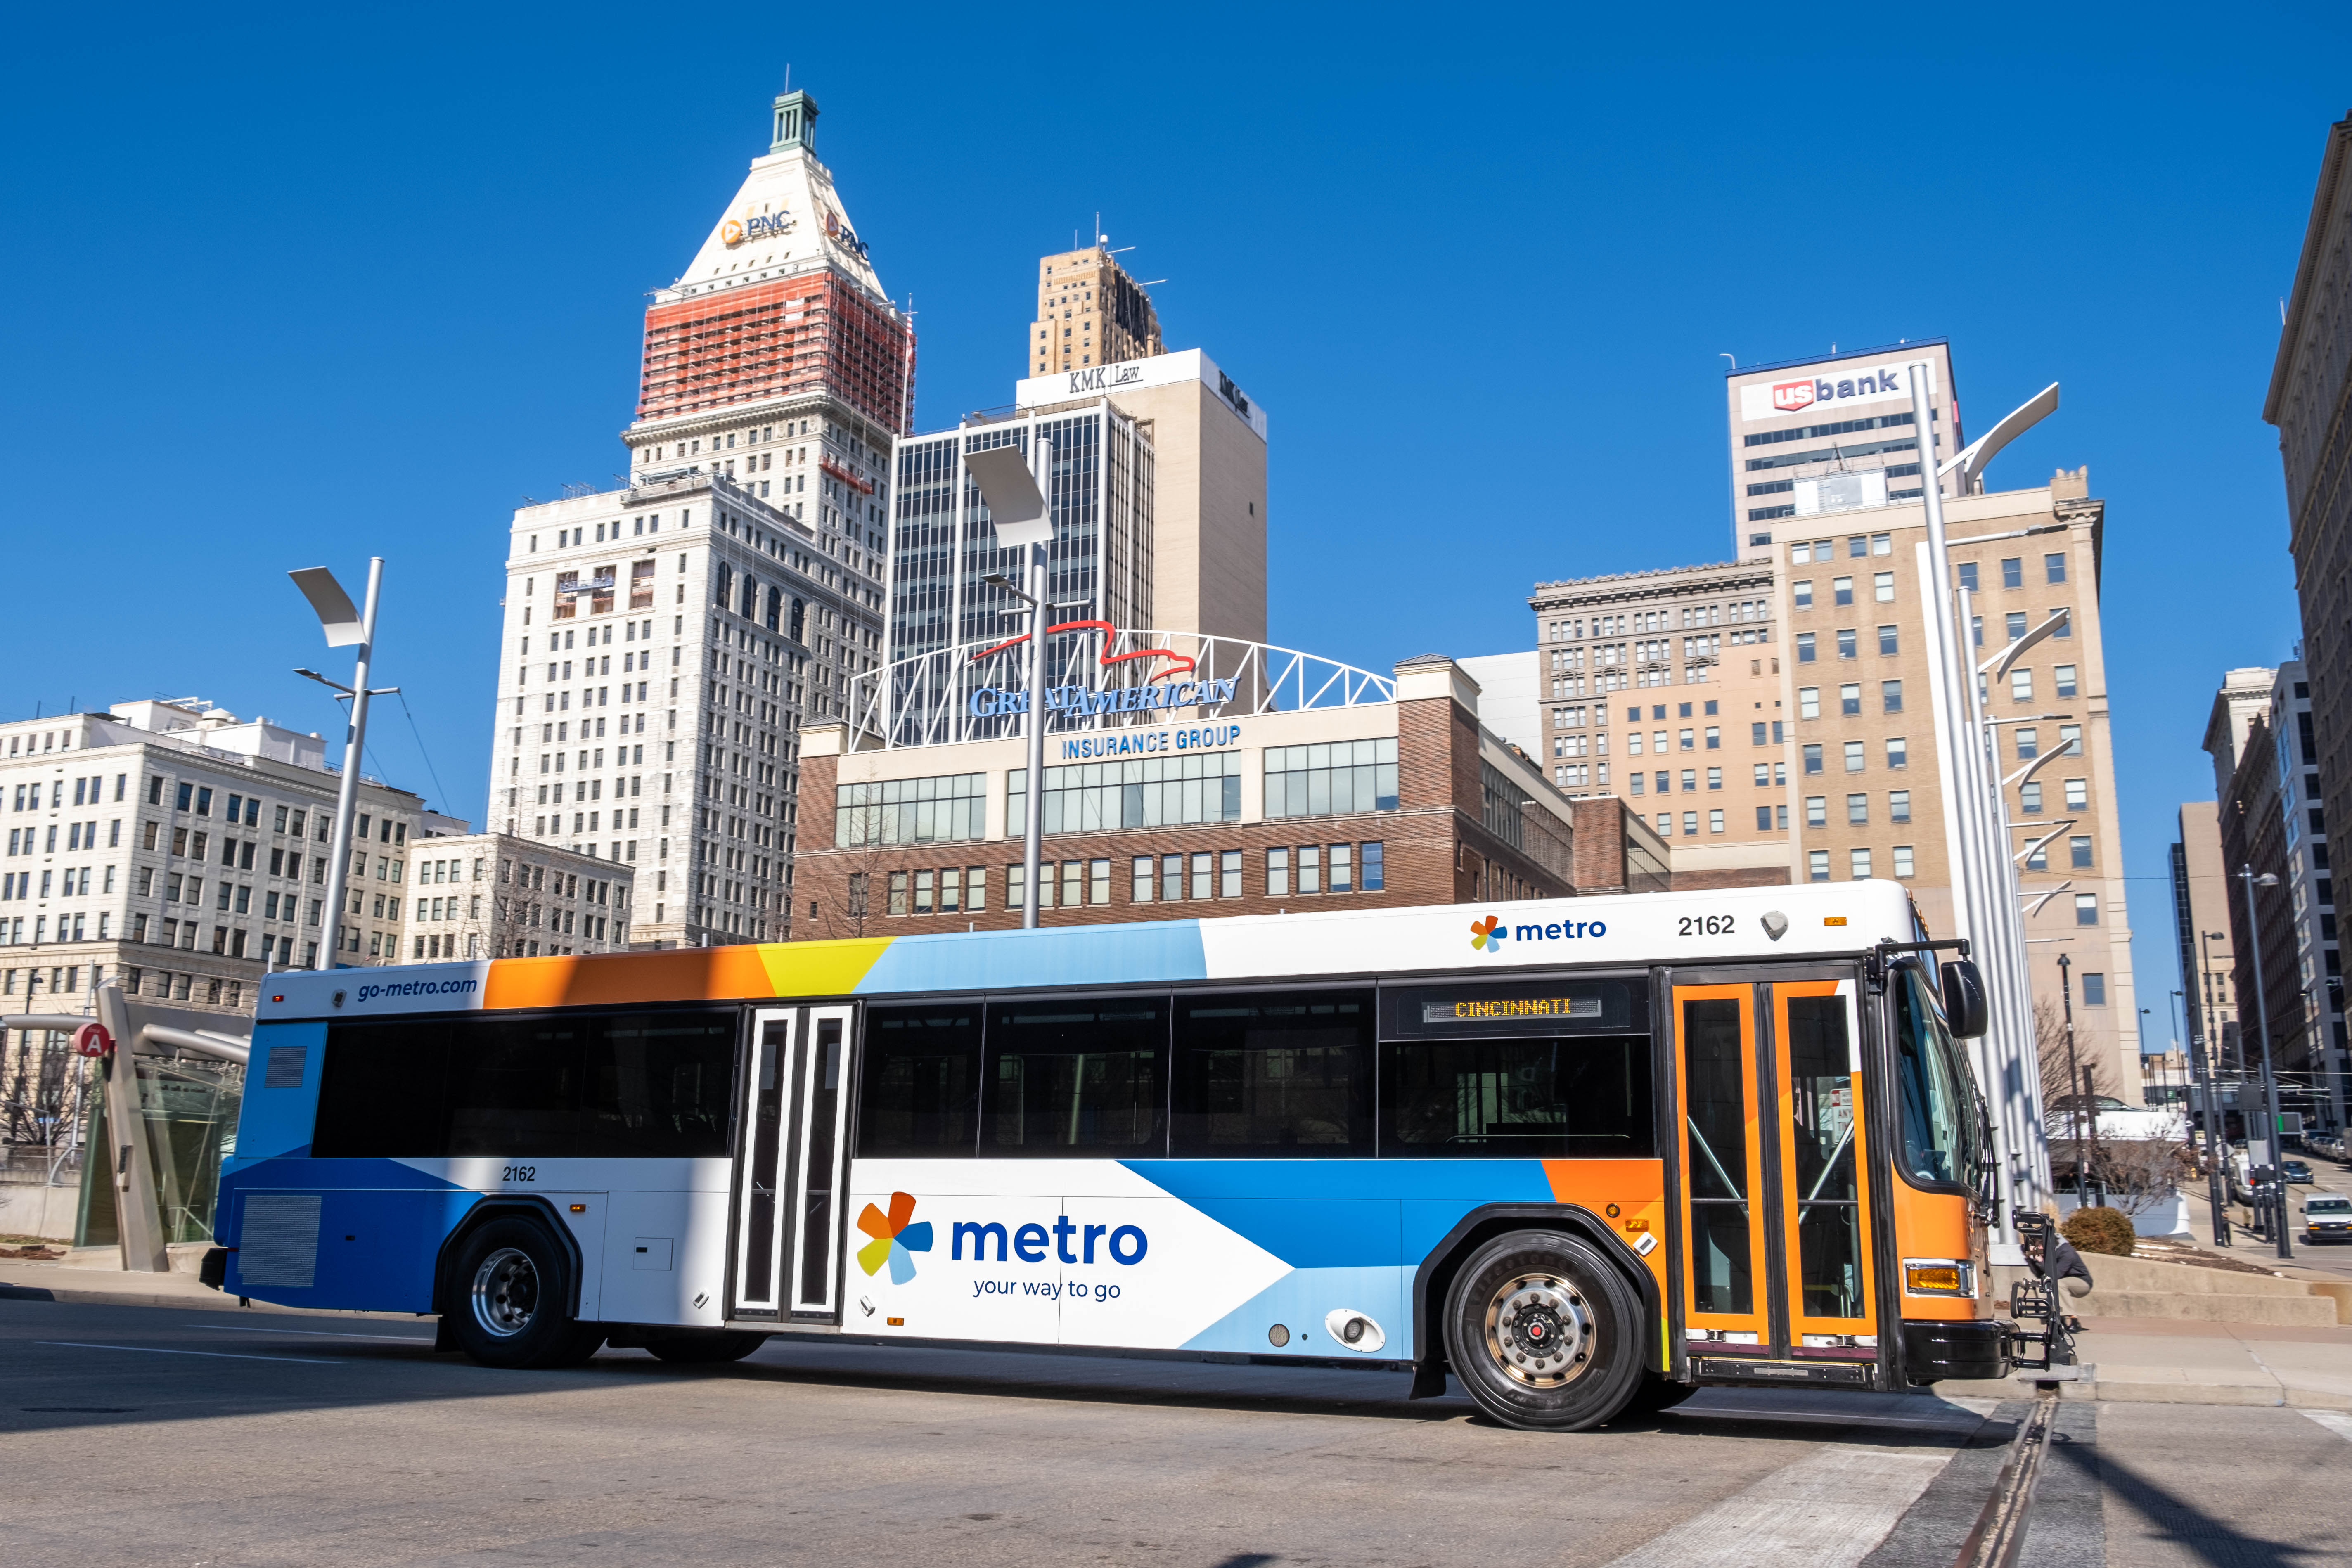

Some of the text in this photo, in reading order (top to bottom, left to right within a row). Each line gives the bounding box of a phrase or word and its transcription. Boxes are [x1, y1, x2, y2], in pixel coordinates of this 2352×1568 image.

[747, 210, 790, 235] PNC
[841, 224, 869, 261] PNC
[1069, 365, 1139, 393] KMK Law
[1062, 725, 1240, 760] INSURANCE GROUP
[1516, 919, 1606, 941] metro
[1678, 915, 1735, 936] 2162
[357, 979, 477, 1002] go-metro.com
[1455, 998, 1571, 1017] CINCINNATI
[85, 1034, 102, 1053] A
[502, 1166, 535, 1182] 2162
[952, 1215, 1148, 1265] metro
[973, 1280, 1121, 1302] your way to go
